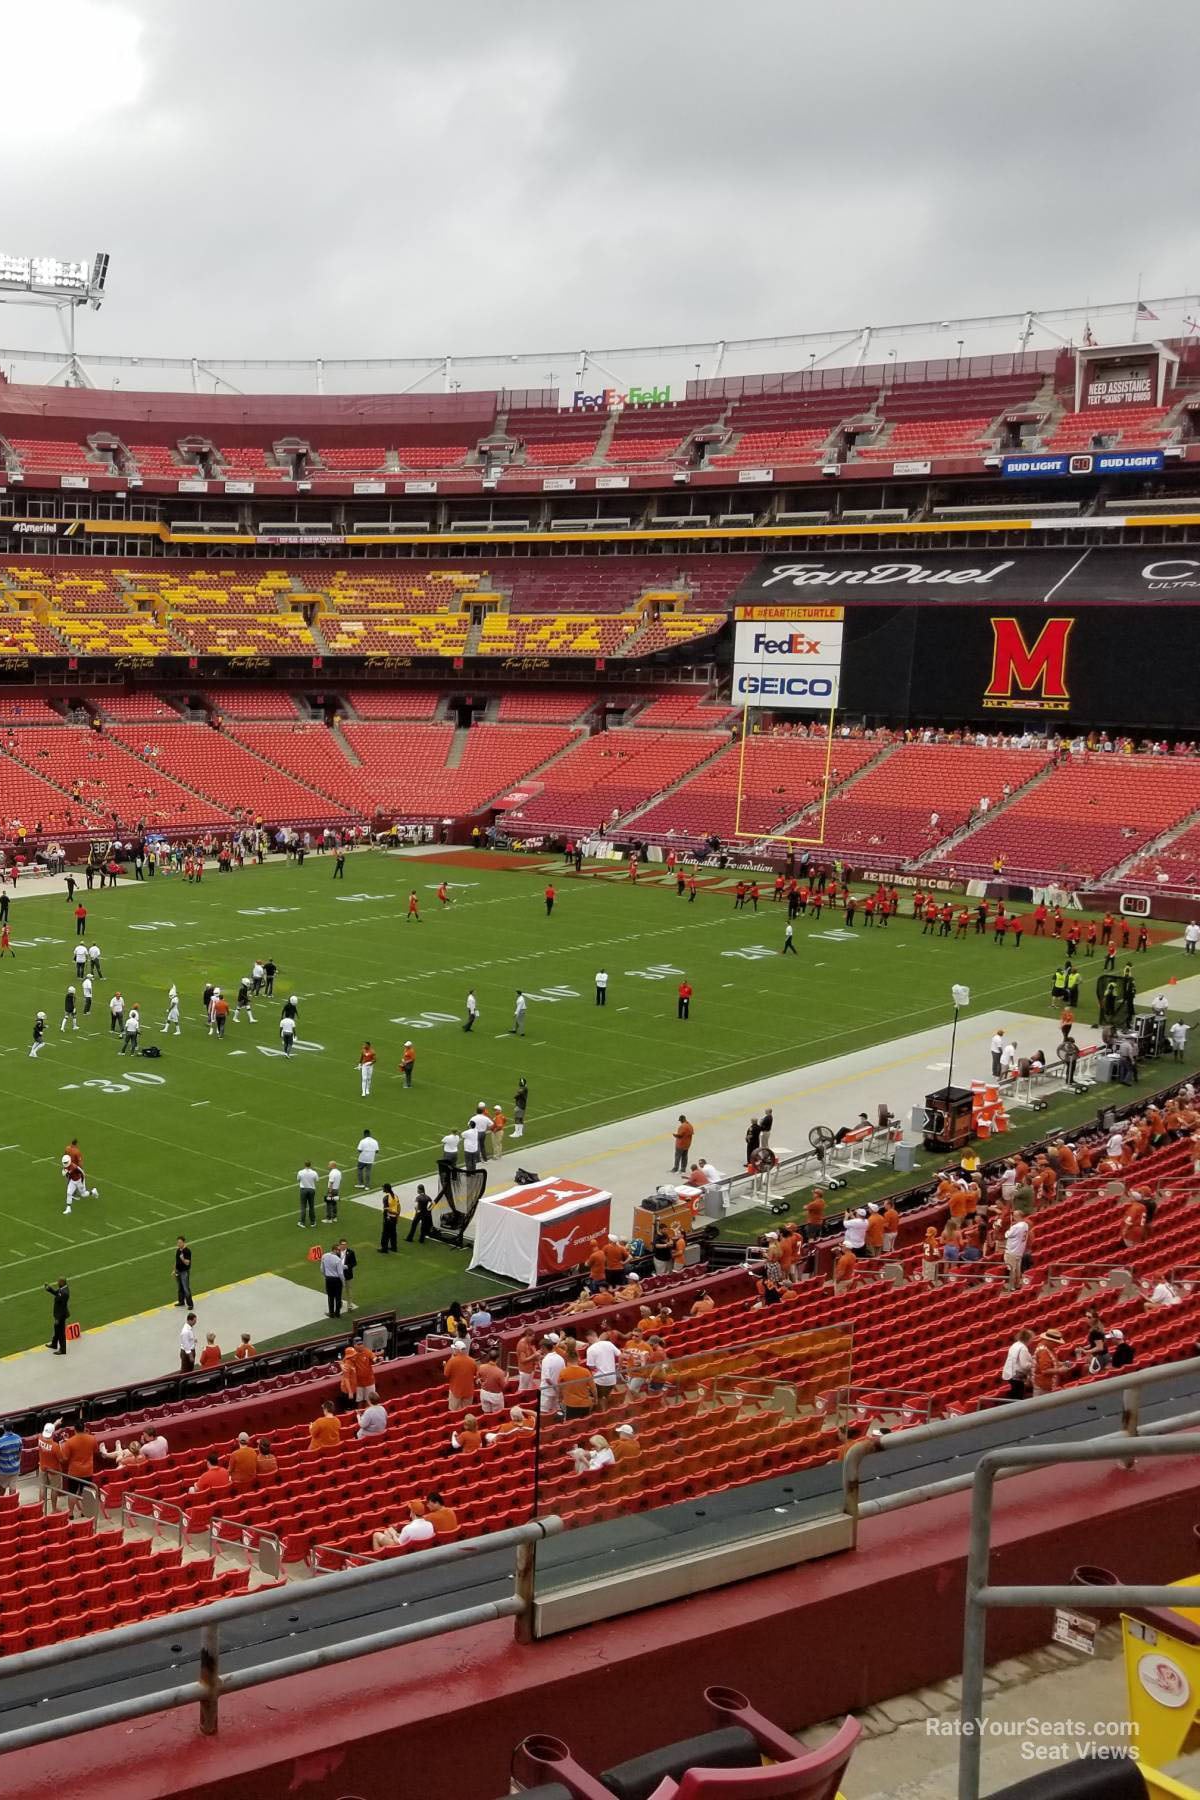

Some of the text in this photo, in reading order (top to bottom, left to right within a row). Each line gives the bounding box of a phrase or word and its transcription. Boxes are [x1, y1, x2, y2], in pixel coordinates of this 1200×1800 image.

[1089, 379, 1151, 395] NEED ASSISTANCE
[574, 385, 670, 407] FedExField
[1088, 396, 1100, 405] TEXT
[1125, 393, 1132, 402] TO
[1008, 461, 1062, 472] BUD LIGHT
[1073, 460, 1089, 470] 40
[1100, 456, 1158, 468] BUD LIGHT
[762, 561, 1016, 586] FanDuel
[757, 607, 835, 618] #FEARTHETURTLE
[753, 633, 822, 654] FedEx
[984, 617, 1076, 699] M
[738, 676, 833, 697] GEICO
[1125, 899, 1146, 912] 40
[720, 947, 779, 960] 20
[624, 965, 686, 980] 30
[521, 987, 581, 1002] 40
[389, 1011, 462, 1029] 50
[83, 1071, 166, 1093] 30
[312, 1246, 322, 1259] 20
[69, 1324, 80, 1339] 10
